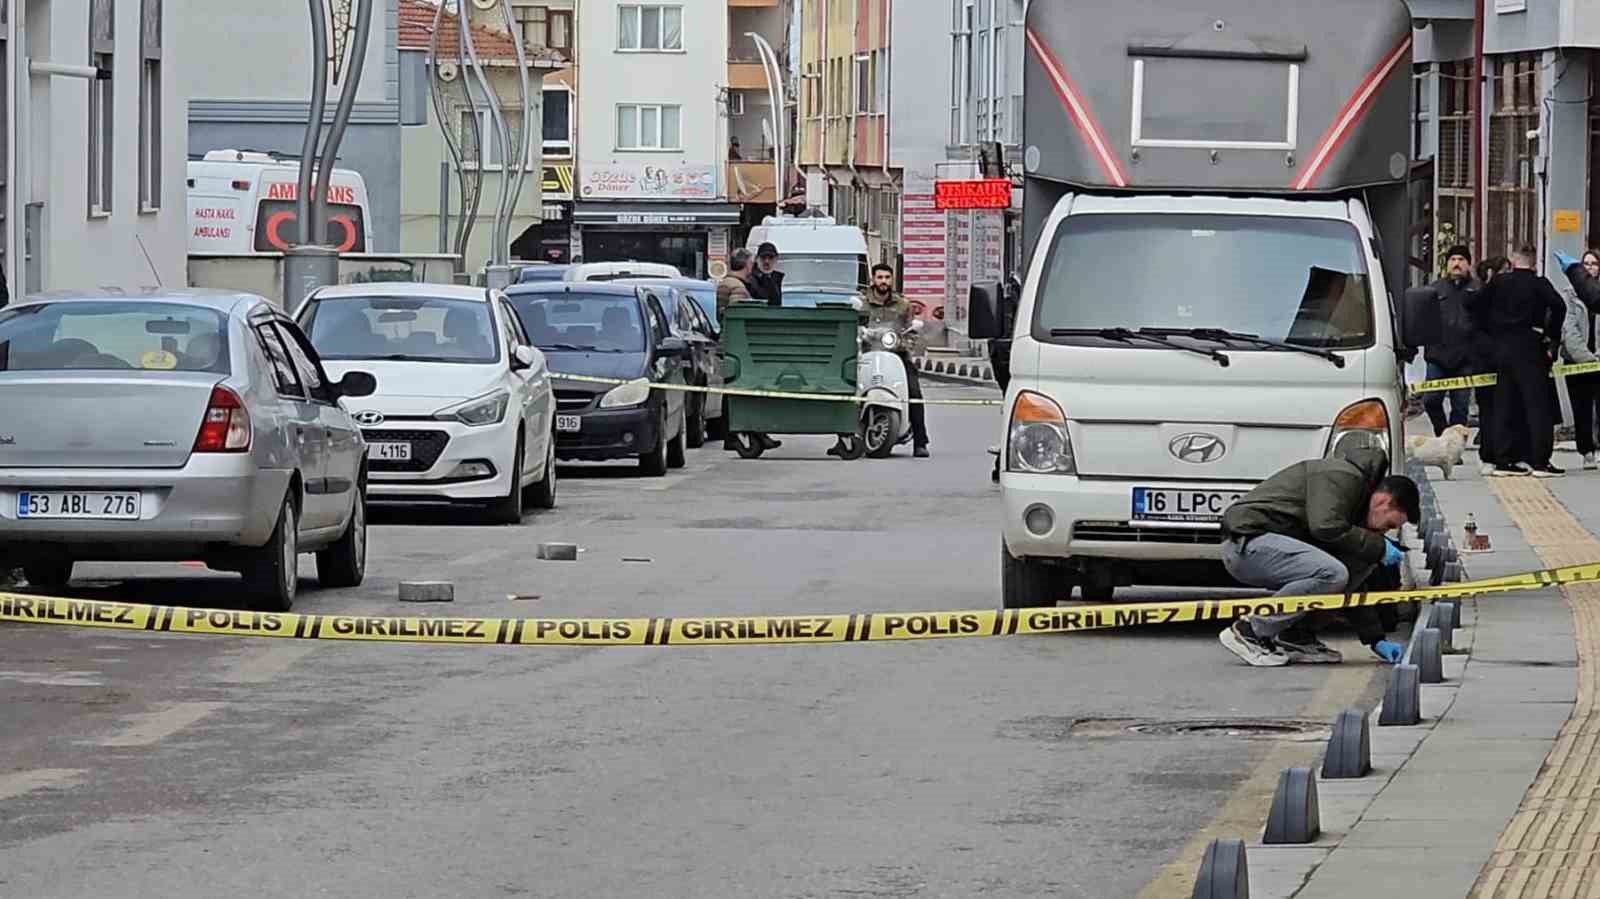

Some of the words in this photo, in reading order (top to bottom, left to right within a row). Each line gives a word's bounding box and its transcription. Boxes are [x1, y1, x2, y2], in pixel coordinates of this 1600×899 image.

[937, 197, 1009, 208] SCHENGEN
[194, 208, 216, 218] HASTA
[559, 416, 577, 428] 916
[380, 444, 407, 458] 4116
[29, 494, 50, 514] 53
[61, 494, 91, 514] ABL
[103, 495, 136, 514] 276
[1146, 492, 1166, 512] 16
[1177, 492, 1222, 513] LPC
